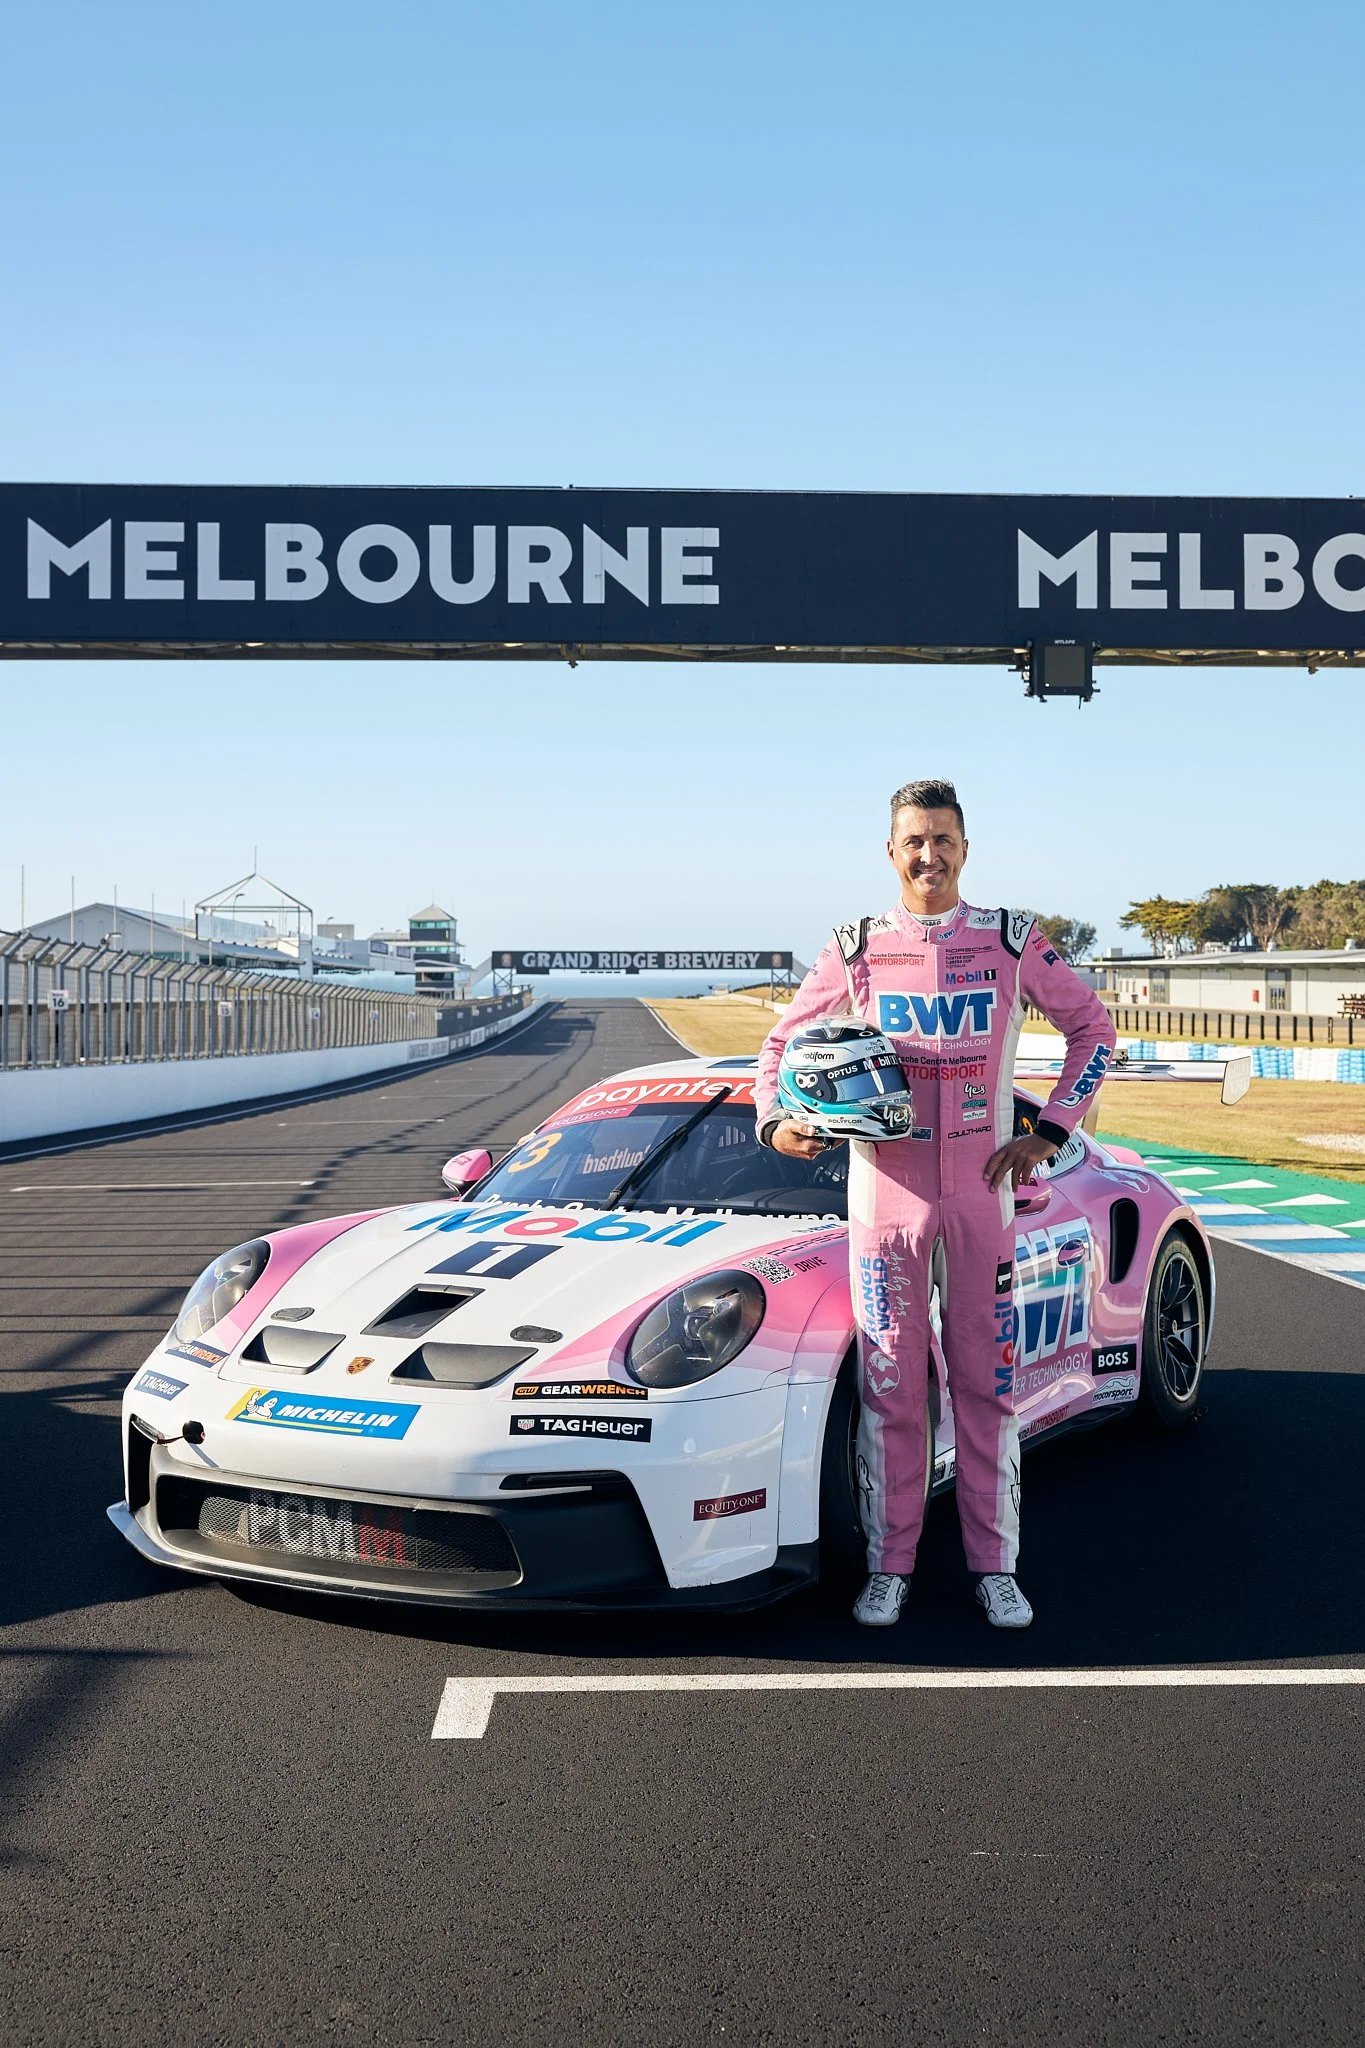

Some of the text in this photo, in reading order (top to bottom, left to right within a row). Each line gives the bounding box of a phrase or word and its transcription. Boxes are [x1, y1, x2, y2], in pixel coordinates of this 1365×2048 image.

[27, 518, 720, 607] MELBOURNE
[1018, 528, 1365, 612] MELBO
[522, 953, 760, 968] GRAND RIDGE BREWERY
[870, 958, 925, 966] MOTORSPORT
[946, 970, 982, 984] Mobil
[53, 998, 65, 1007] 16
[878, 991, 995, 1037] BWT
[900, 1040, 931, 1050] WATER
[932, 1038, 992, 1051] TECHNOLOGY
[863, 1055, 890, 1071] Mobil
[900, 1053, 987, 1065] sche Centre Melbourne
[827, 1065, 858, 1079] OPTUS
[904, 1063, 986, 1080] OTORSPORT
[1074, 1044, 1112, 1095] BWT
[573, 1079, 755, 1113] paynter
[964, 1082, 986, 1098] yes
[884, 1105, 909, 1127] yes
[508, 1132, 563, 1173] 3
[403, 1207, 727, 1247] Mobil
[794, 1256, 827, 1272] DRIVE
[860, 1256, 880, 1346] CHANGE
[872, 1257, 891, 1331] WORLD
[1014, 1222, 1091, 1363] WT
[994, 1301, 1013, 1397] Mobil
[1098, 1352, 1129, 1368] BOSS
[1028, 1351, 1088, 1390] TECHNOLOGY
[541, 1384, 646, 1396] GEARWRENCH
[1093, 1388, 1134, 1401] motorsport
[276, 1404, 399, 1428] MICHELIN
